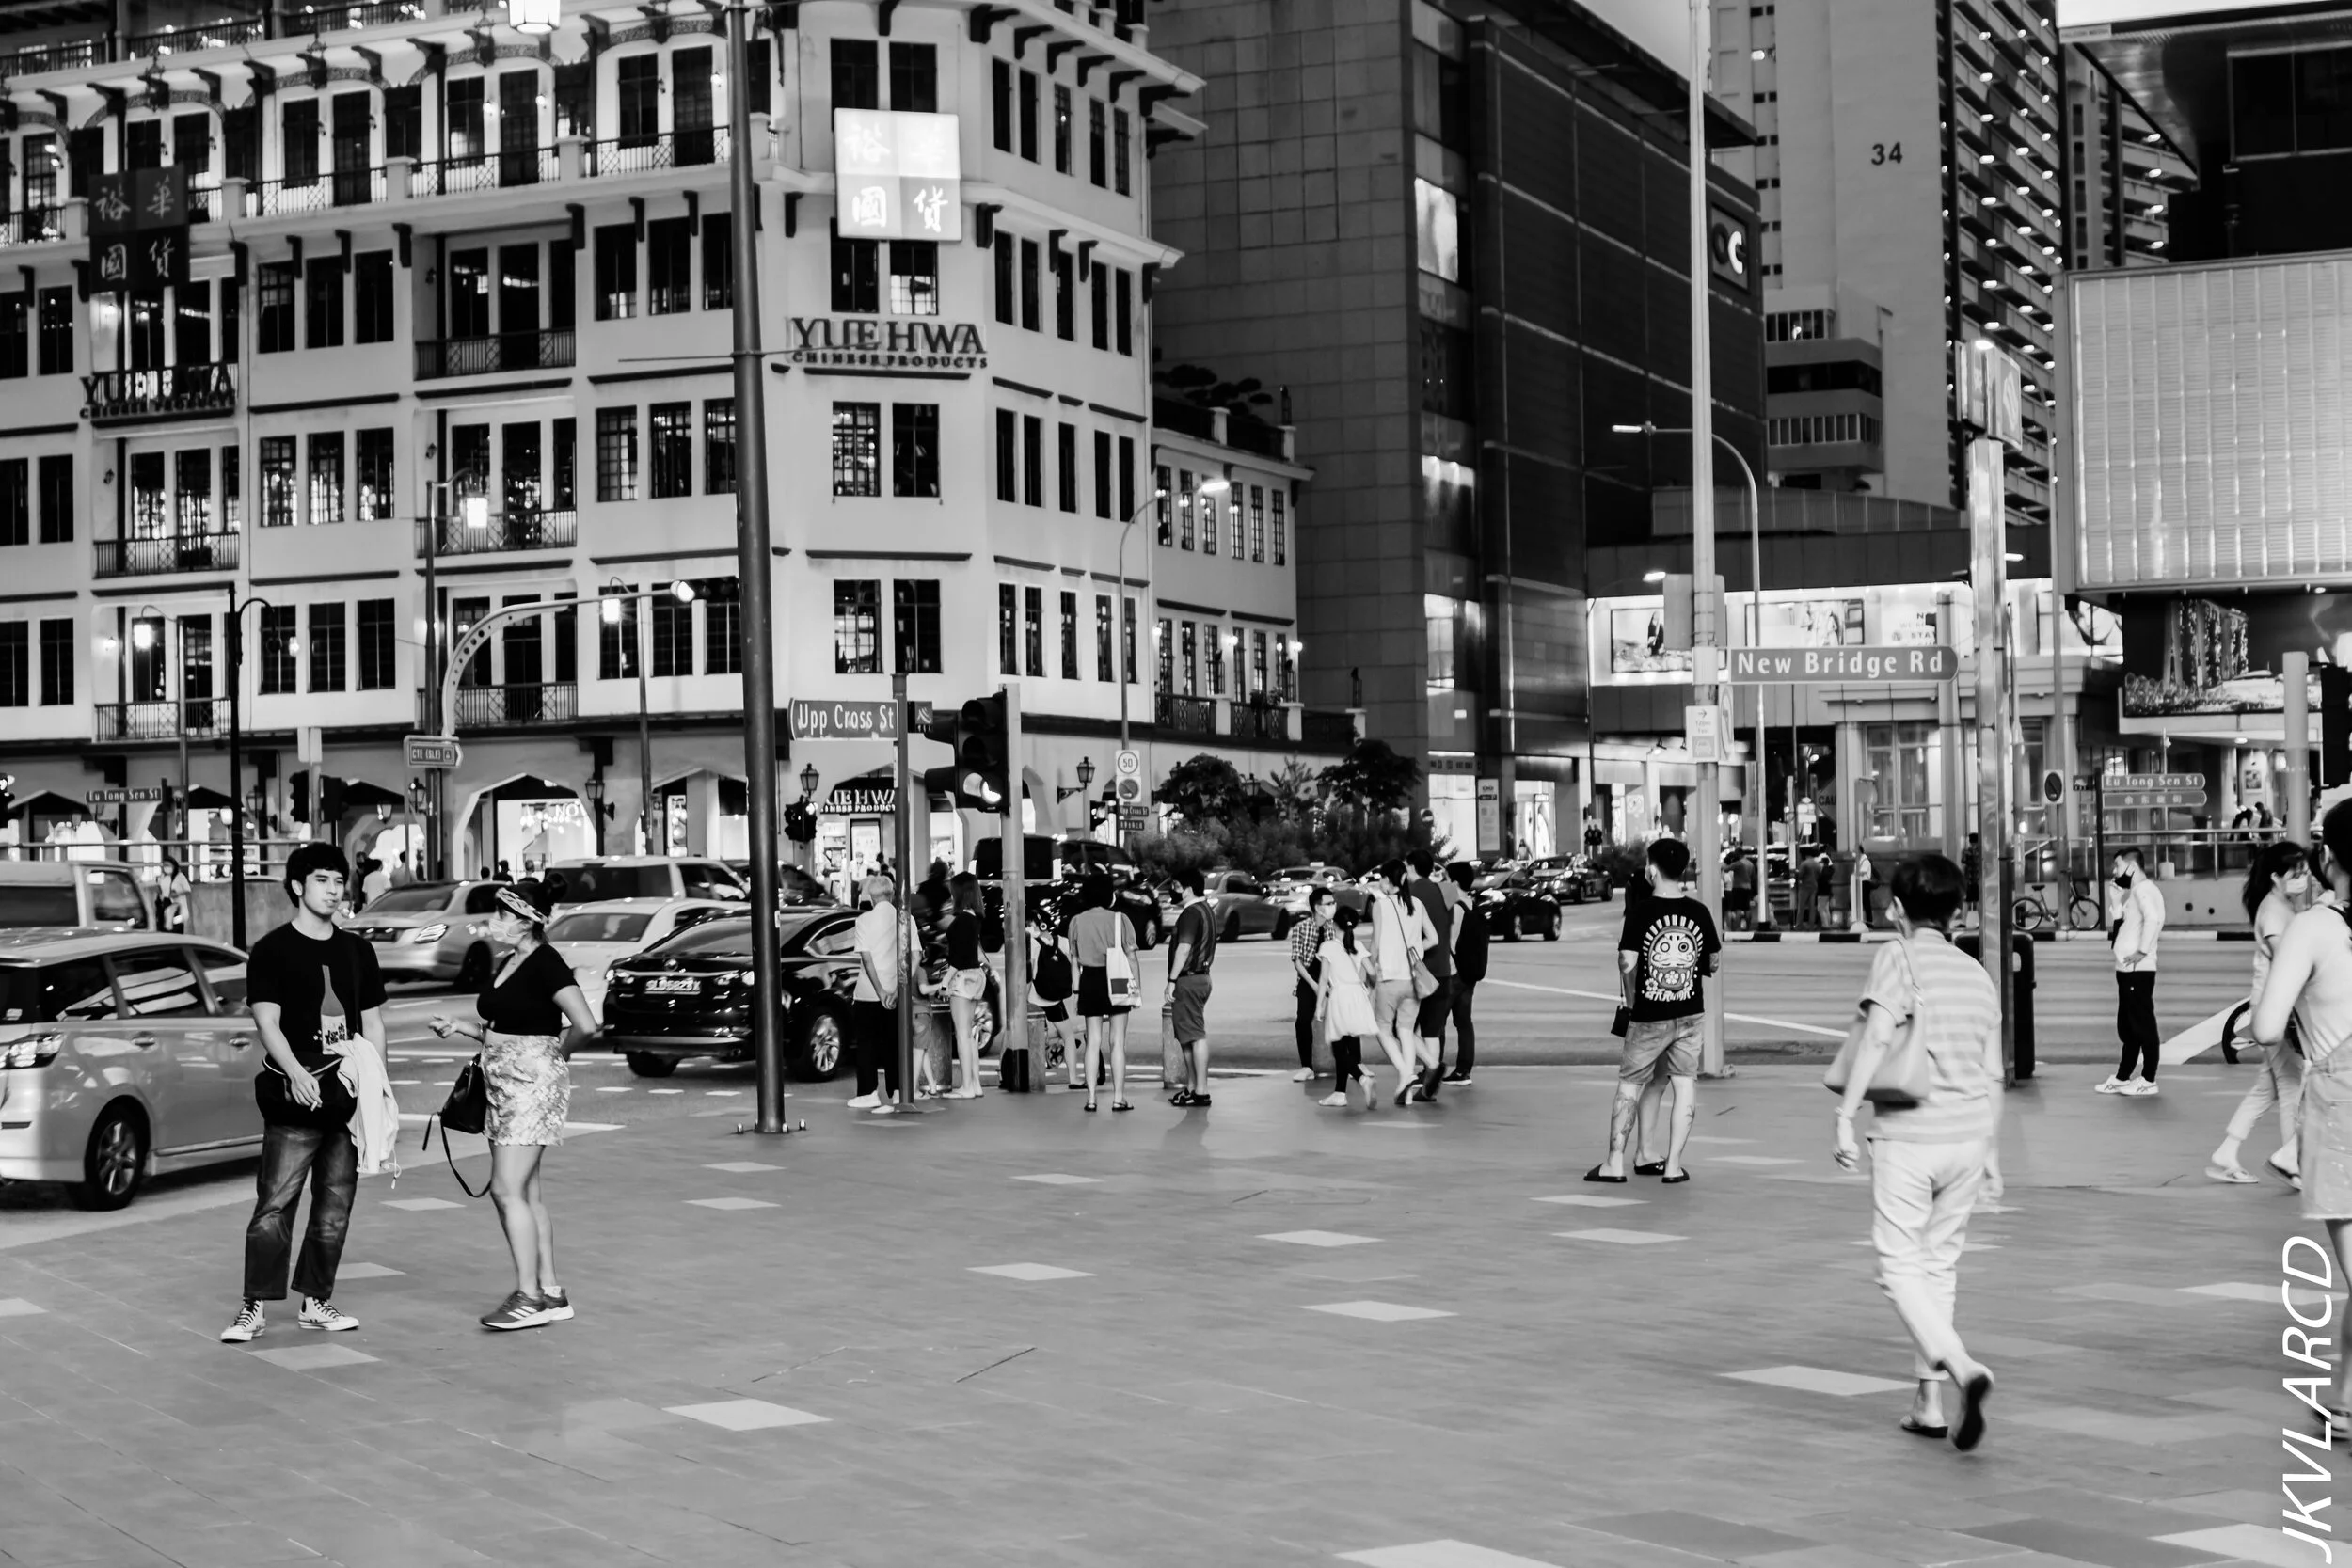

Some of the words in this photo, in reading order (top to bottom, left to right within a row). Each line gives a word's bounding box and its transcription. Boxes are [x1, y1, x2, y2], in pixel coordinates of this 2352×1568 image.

[1871, 142, 1902, 166] 34
[791, 317, 879, 351] YUE
[886, 321, 987, 355] HWA
[792, 351, 881, 366] CHINESE
[887, 354, 988, 370] PRODUCTS
[1738, 652, 1791, 674] New
[1805, 651, 1897, 679] Bridge
[1910, 650, 1943, 673] Rd
[798, 703, 828, 735] Upp
[834, 704, 873, 729] Cross
[879, 705, 894, 731] St
[1122, 758, 1134, 768] 50
[2106, 776, 2121, 786] Eu
[2126, 774, 2153, 789] Tong
[2158, 774, 2181, 786] Sen
[2185, 774, 2198, 785] St
[1819, 795, 1837, 807] CAU
